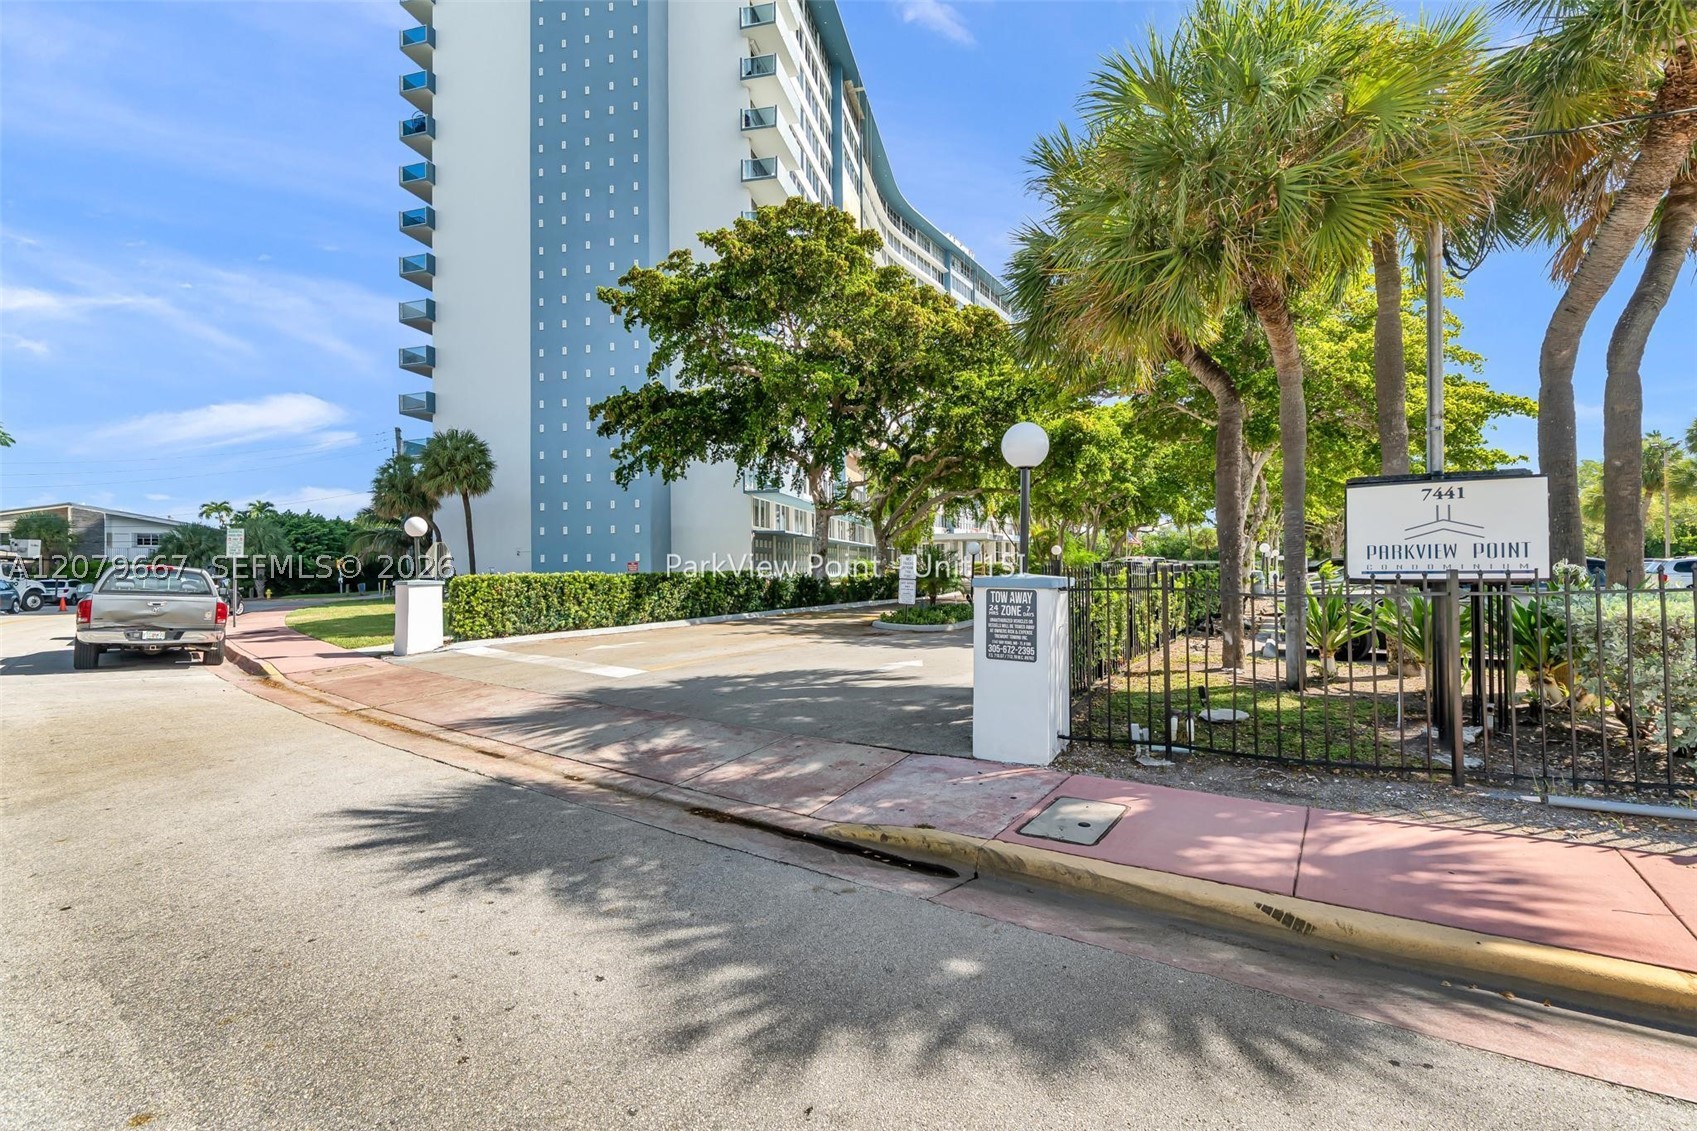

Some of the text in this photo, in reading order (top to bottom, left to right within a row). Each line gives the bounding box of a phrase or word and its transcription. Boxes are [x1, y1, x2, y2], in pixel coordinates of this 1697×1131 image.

[1421, 486, 1465, 501] 7441
[1366, 541, 1532, 560] PARKVIEW POINT
[1366, 562, 1530, 571] CONDOMINIUM
[990, 591, 1033, 604] TOW AWAY
[1000, 605, 1022, 616] ZONE
[988, 644, 1035, 656] 305-672-2395
